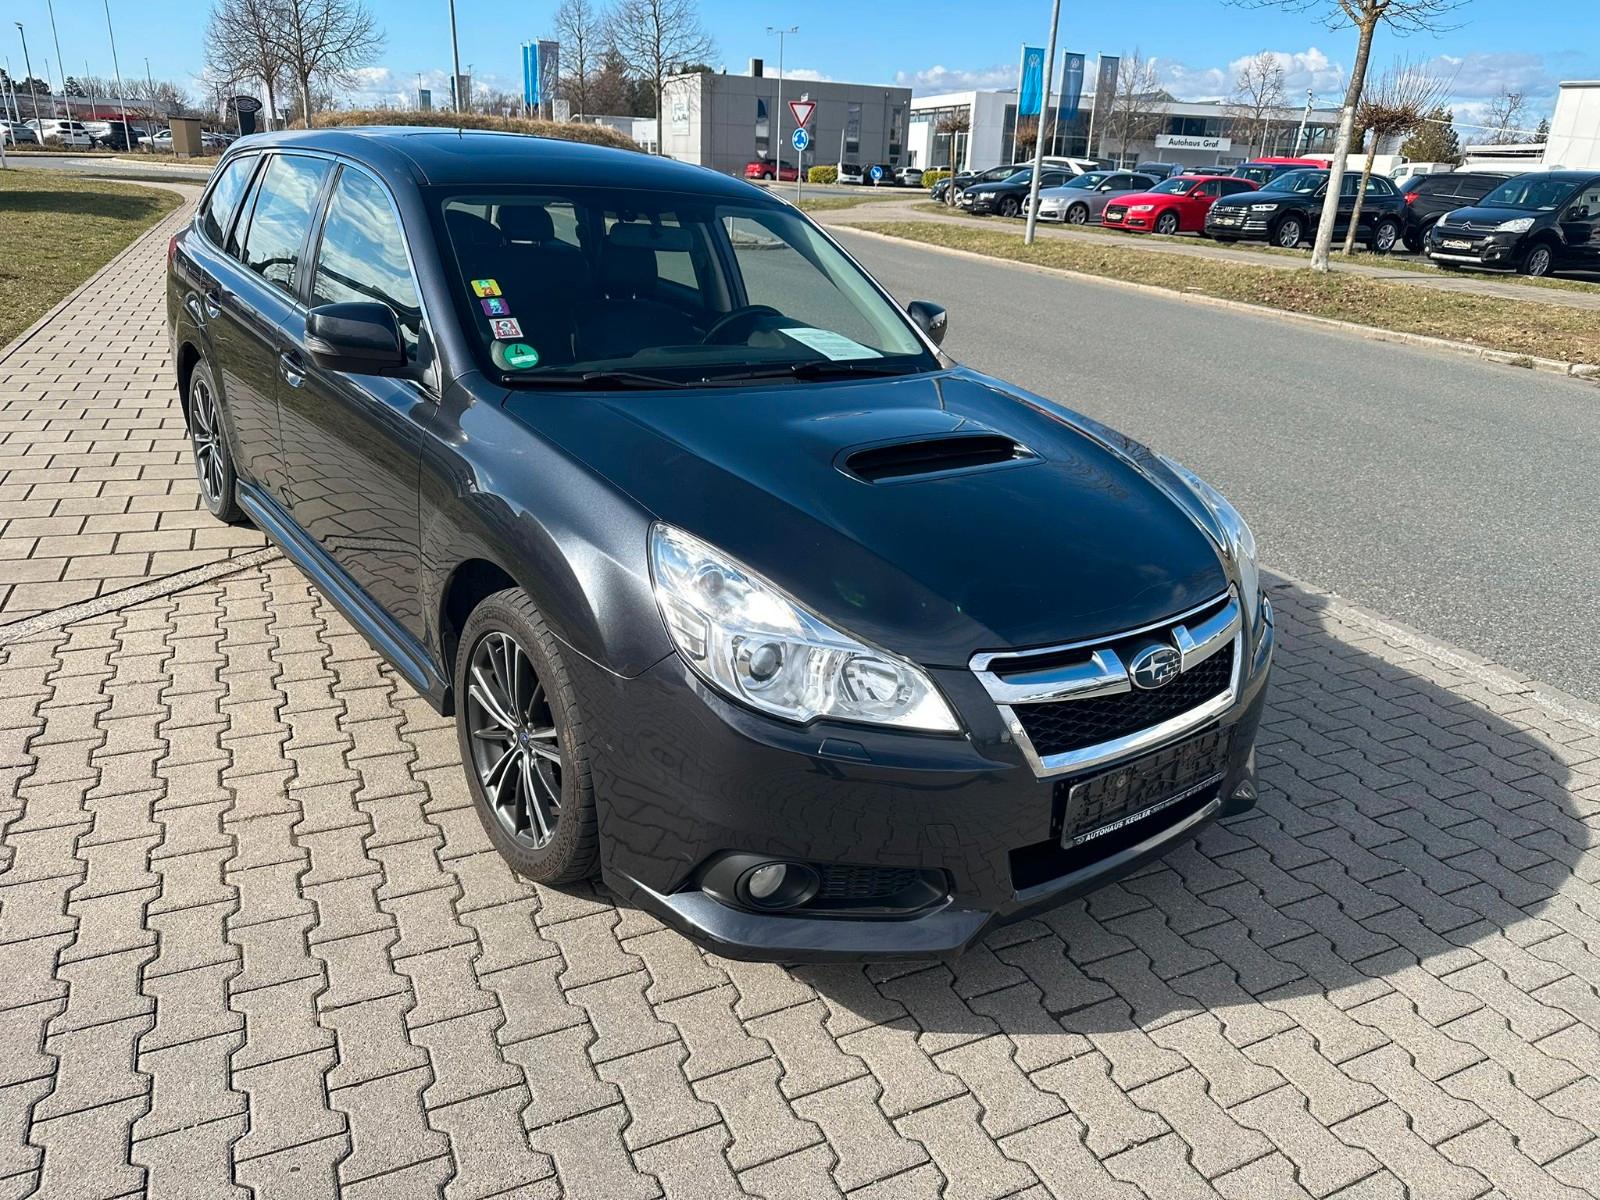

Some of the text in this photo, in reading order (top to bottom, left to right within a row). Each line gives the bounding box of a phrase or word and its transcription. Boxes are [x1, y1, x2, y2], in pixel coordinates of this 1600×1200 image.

[1168, 138, 1219, 148] Autohaus Graf
[1085, 809, 1151, 842] AUTOHAUS KEGLER
